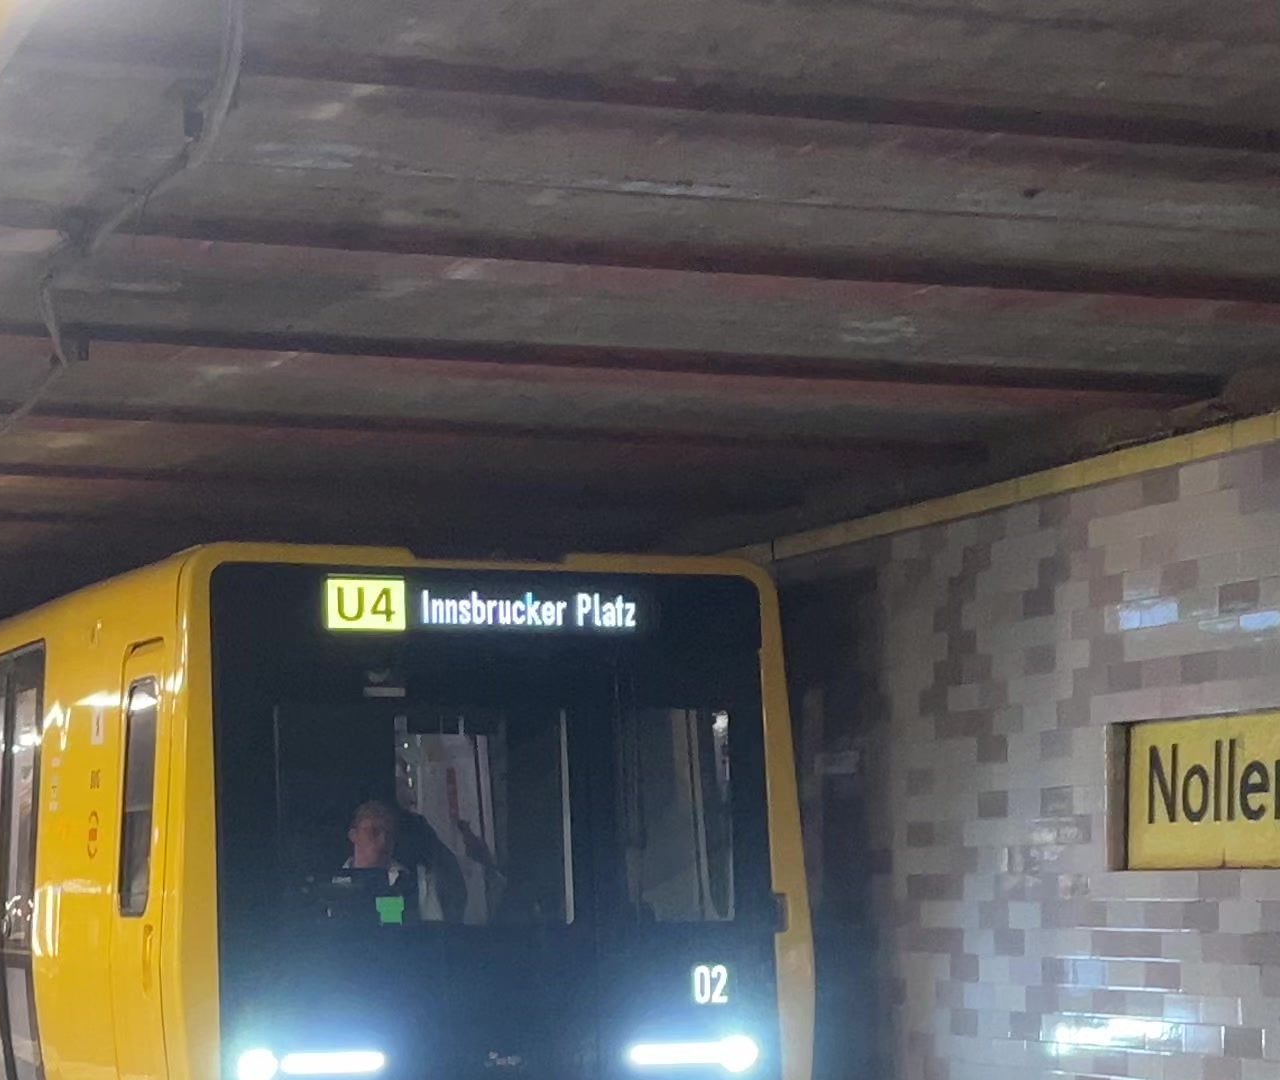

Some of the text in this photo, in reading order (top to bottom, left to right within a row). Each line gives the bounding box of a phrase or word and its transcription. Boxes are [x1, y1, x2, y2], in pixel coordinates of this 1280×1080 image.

[336, 586, 637, 627] U4 Innsbrucker Platz
[694, 963, 728, 1004] 02
